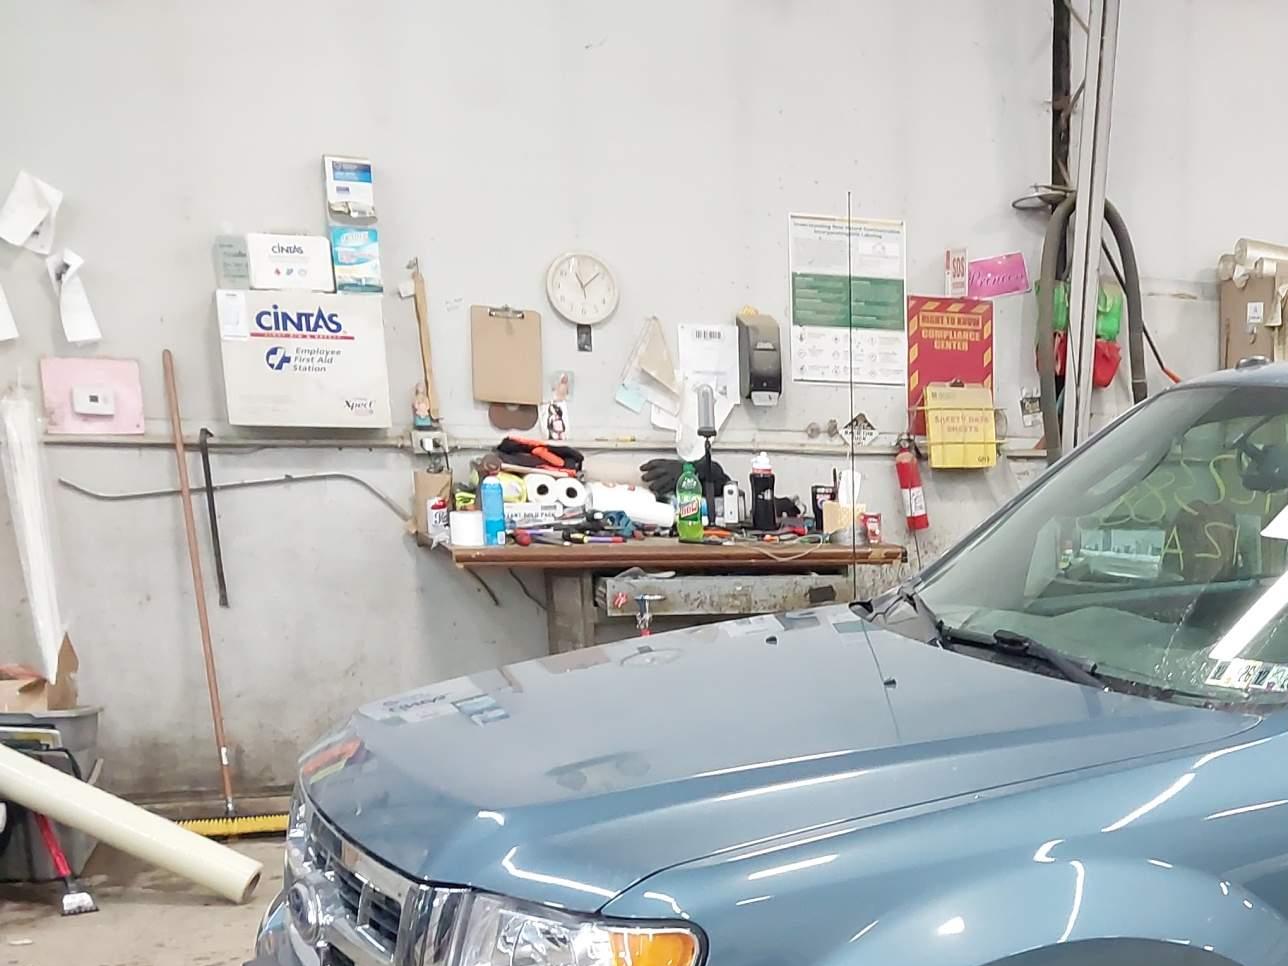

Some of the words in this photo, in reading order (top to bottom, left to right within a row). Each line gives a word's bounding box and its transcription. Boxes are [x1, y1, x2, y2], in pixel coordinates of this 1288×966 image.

[255, 303, 343, 333] CINTAS
[946, 315, 955, 325] TO
[921, 329, 981, 341] COMPLIANCE
[934, 340, 969, 352] CENTER
[295, 347, 342, 357] Employee
[294, 356, 315, 364] First
[317, 356, 334, 364] Aid
[293, 364, 327, 372] Station
